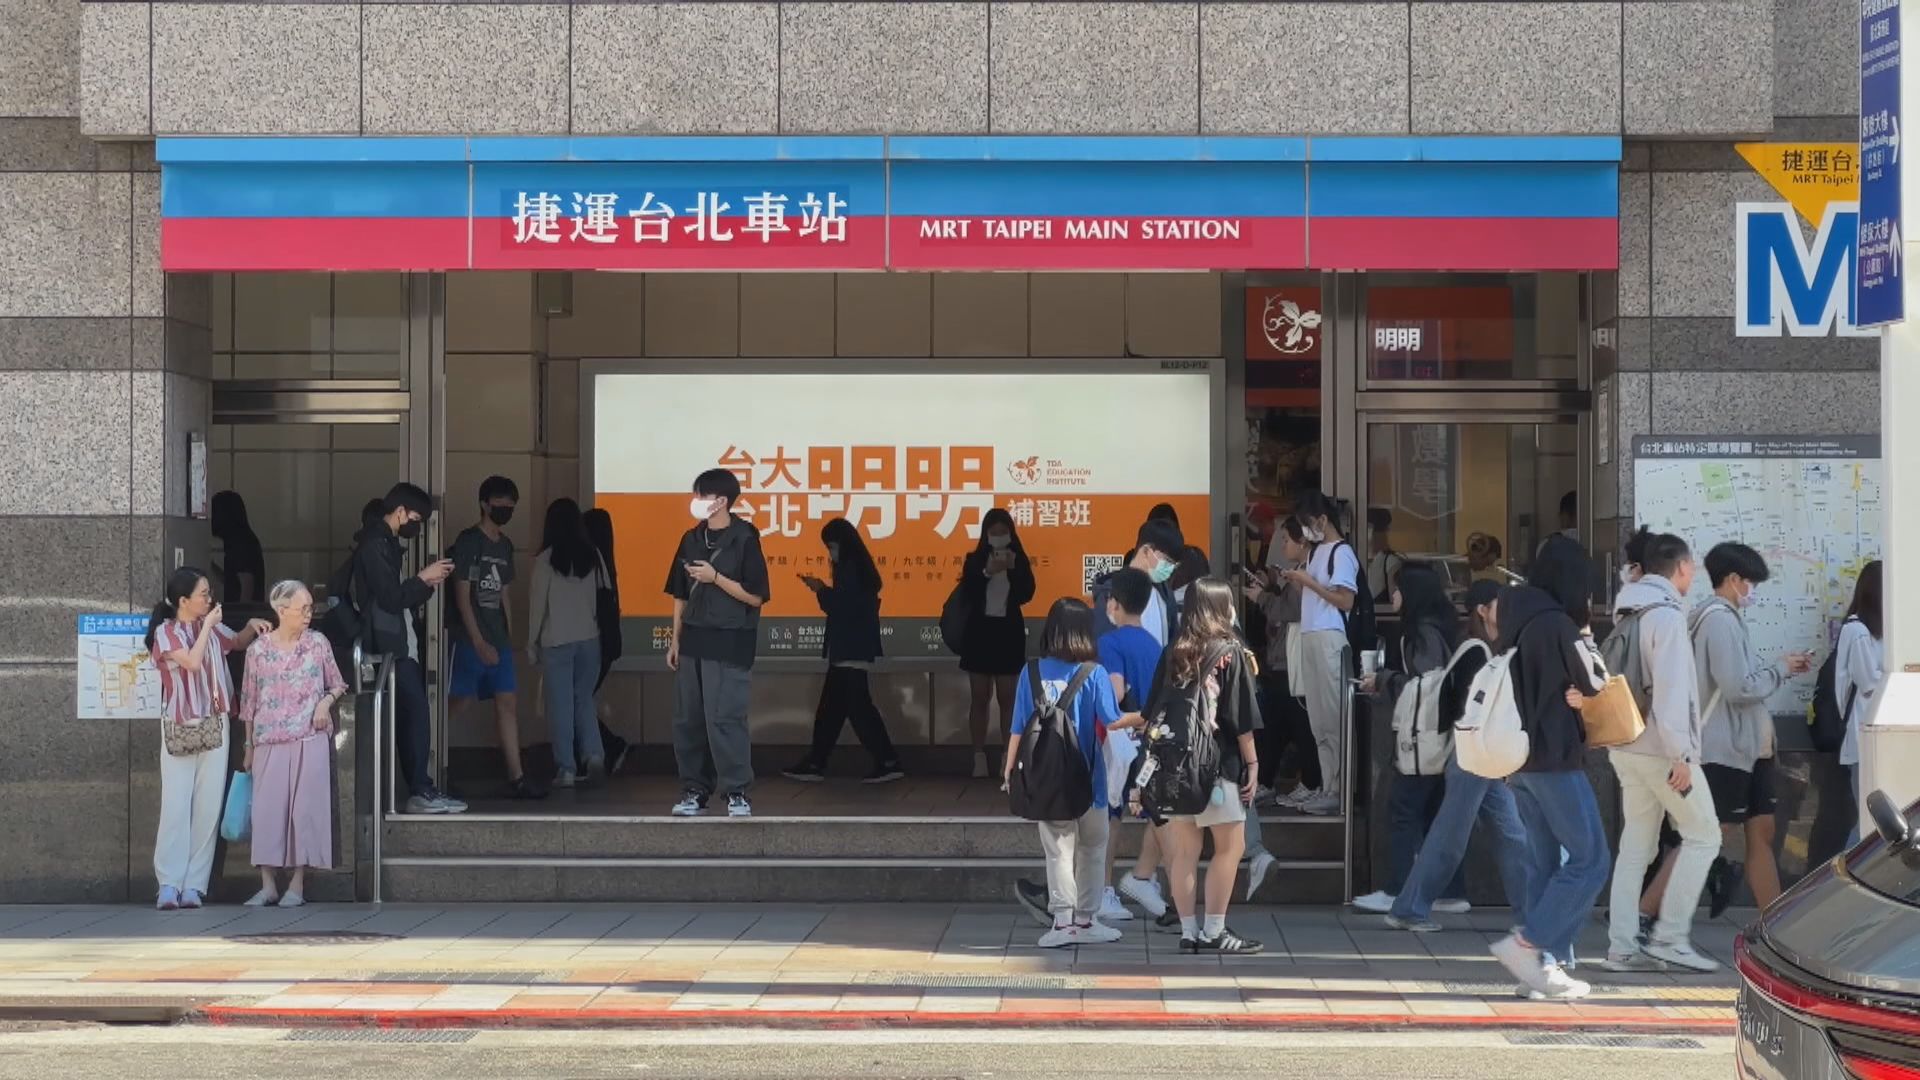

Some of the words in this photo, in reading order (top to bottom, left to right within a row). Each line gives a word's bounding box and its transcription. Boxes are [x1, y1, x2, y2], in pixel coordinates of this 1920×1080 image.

[1782, 150, 1859, 171] 捷運台
[1793, 174, 1818, 184] MRT
[1822, 174, 1853, 186] Taipei
[512, 191, 848, 244] 捷運台北車站
[920, 220, 972, 239] MRT
[982, 220, 1052, 239] TAIPEI
[1064, 220, 1129, 239] MAIN
[1141, 219, 1240, 240] STATION
[1740, 206, 1861, 332] M
[1375, 327, 1421, 351] 明明
[717, 445, 801, 489] 台大
[808, 446, 994, 540] 明明
[1007, 498, 1091, 527] 補習班
